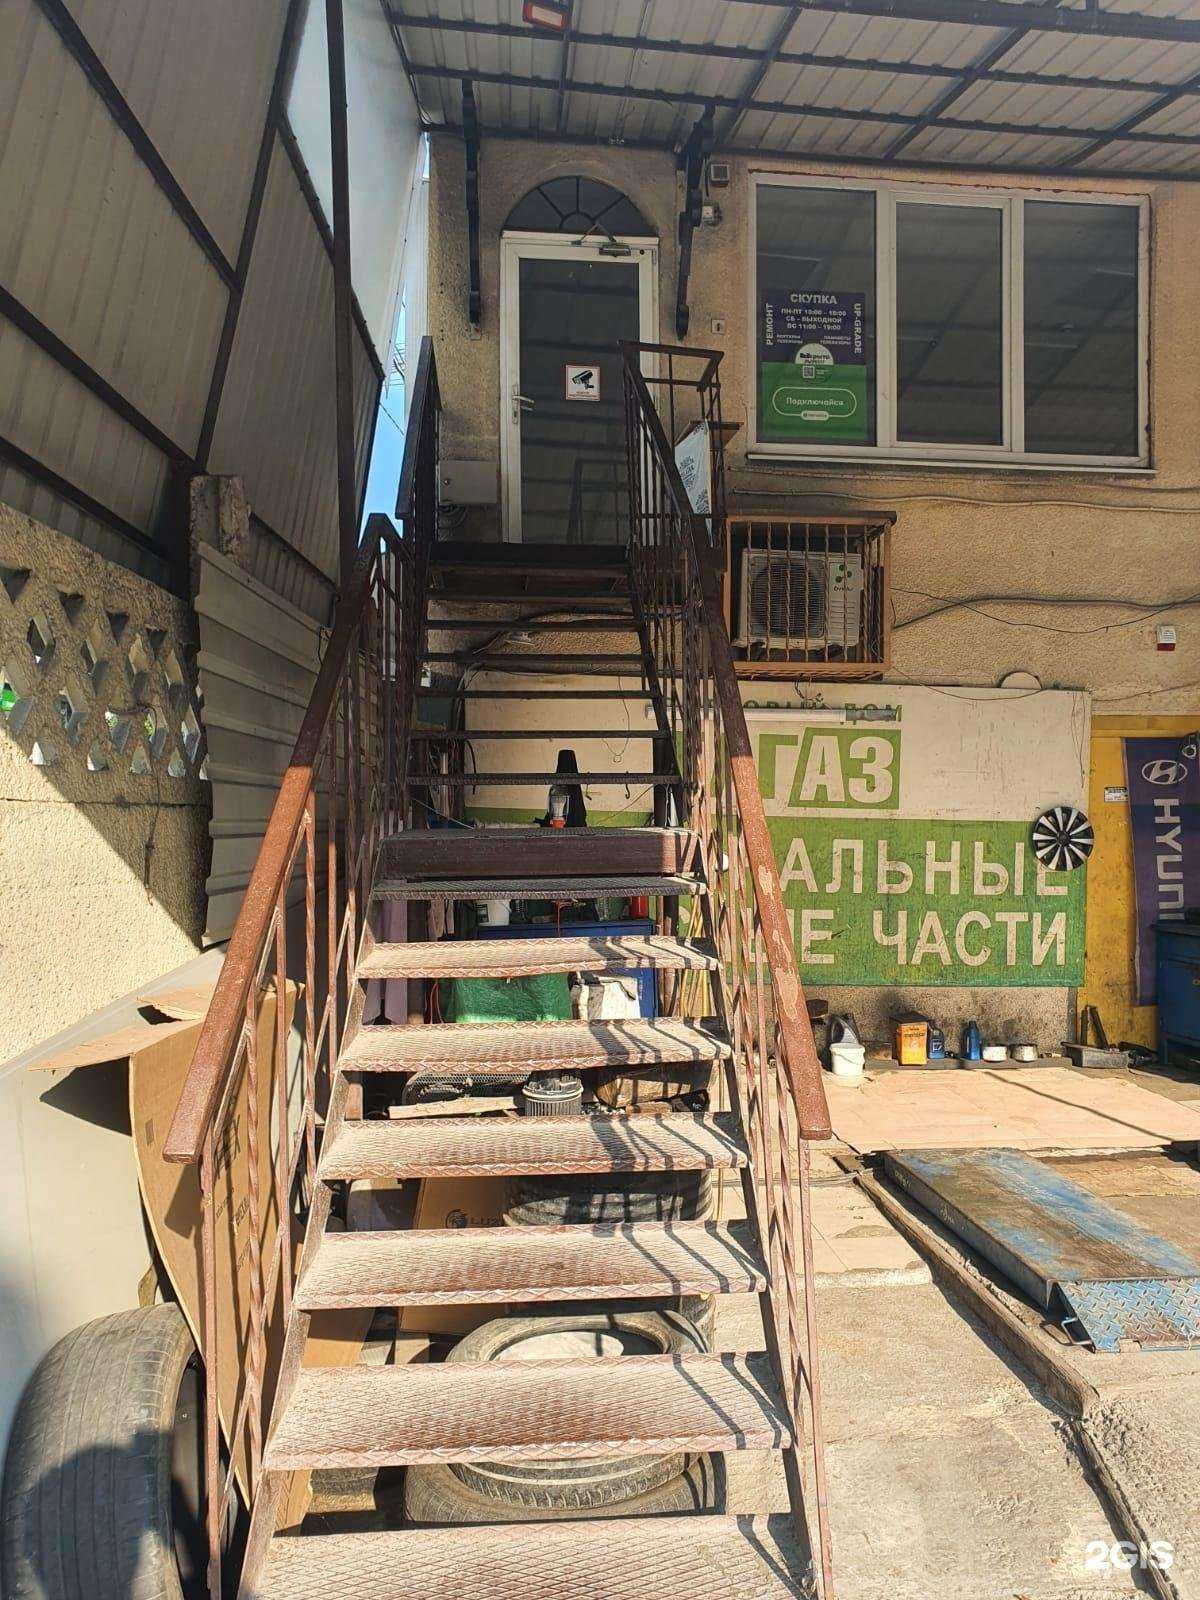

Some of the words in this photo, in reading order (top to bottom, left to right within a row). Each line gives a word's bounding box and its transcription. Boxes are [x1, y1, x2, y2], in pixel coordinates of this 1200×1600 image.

[790, 294, 837, 304] СКУПКА
[765, 303, 774, 346] РЕМОНТ
[802, 316, 842, 324] ВЫХОДНОЙ
[853, 303, 862, 354] UP-GRADE
[786, 397, 844, 407] Подключайся
[872, 909, 1067, 966] ЧАСТИ
